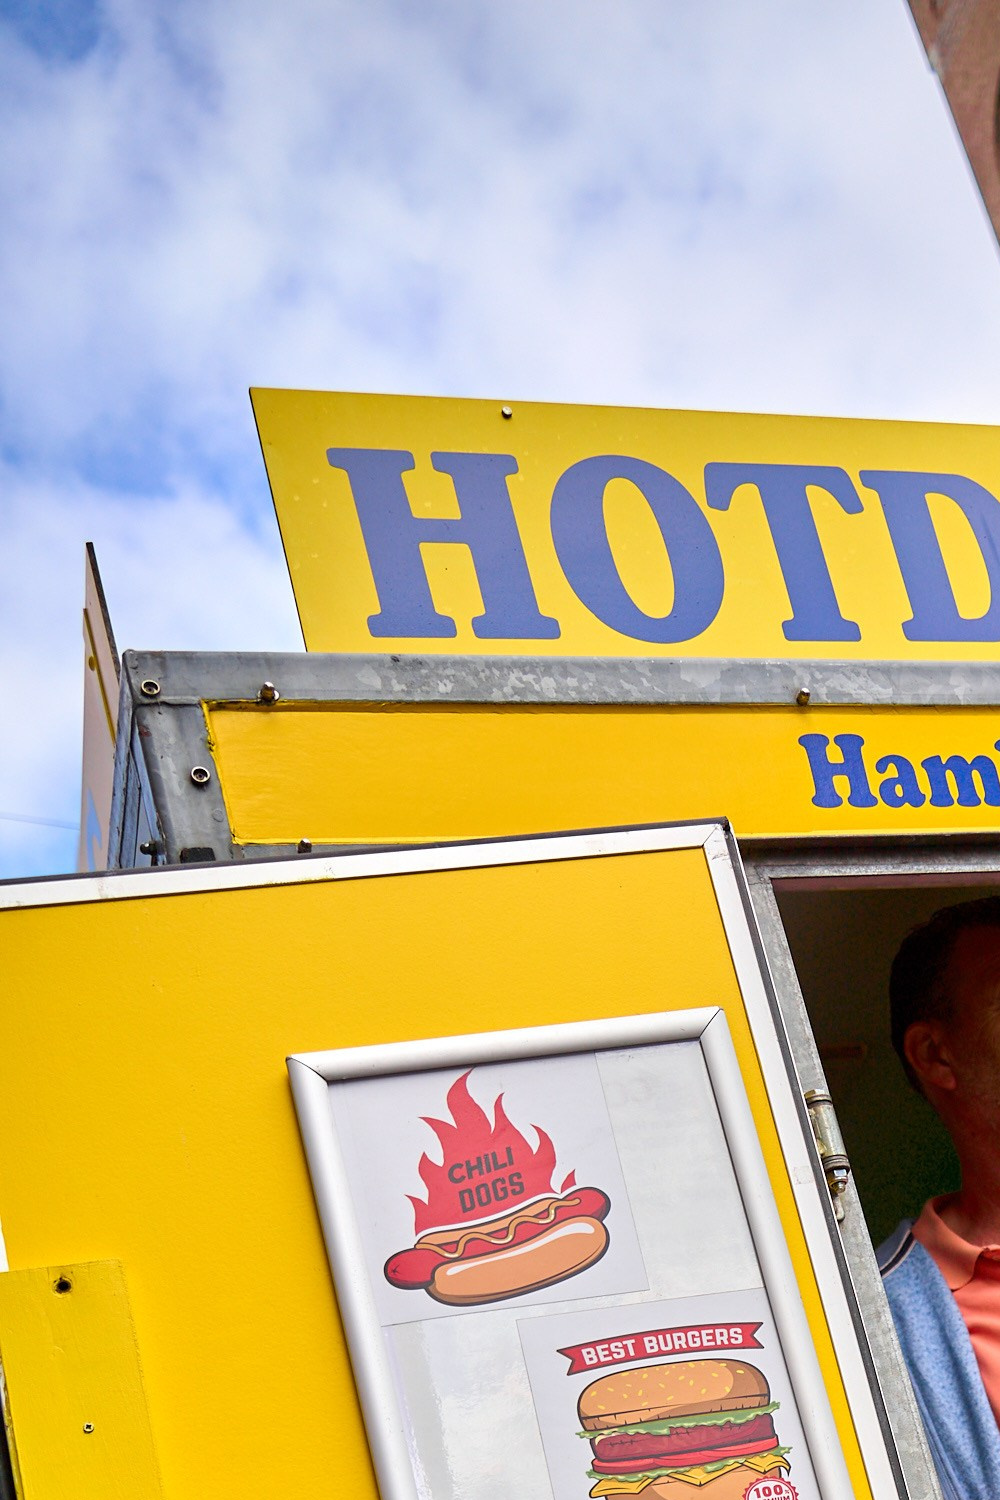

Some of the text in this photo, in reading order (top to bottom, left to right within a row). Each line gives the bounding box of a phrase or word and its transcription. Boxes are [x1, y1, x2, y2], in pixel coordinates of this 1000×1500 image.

[448, 1146, 514, 1184] CHILI
[458, 1172, 525, 1213] DOGS
[581, 1328, 743, 1365] BEST BURGERS
